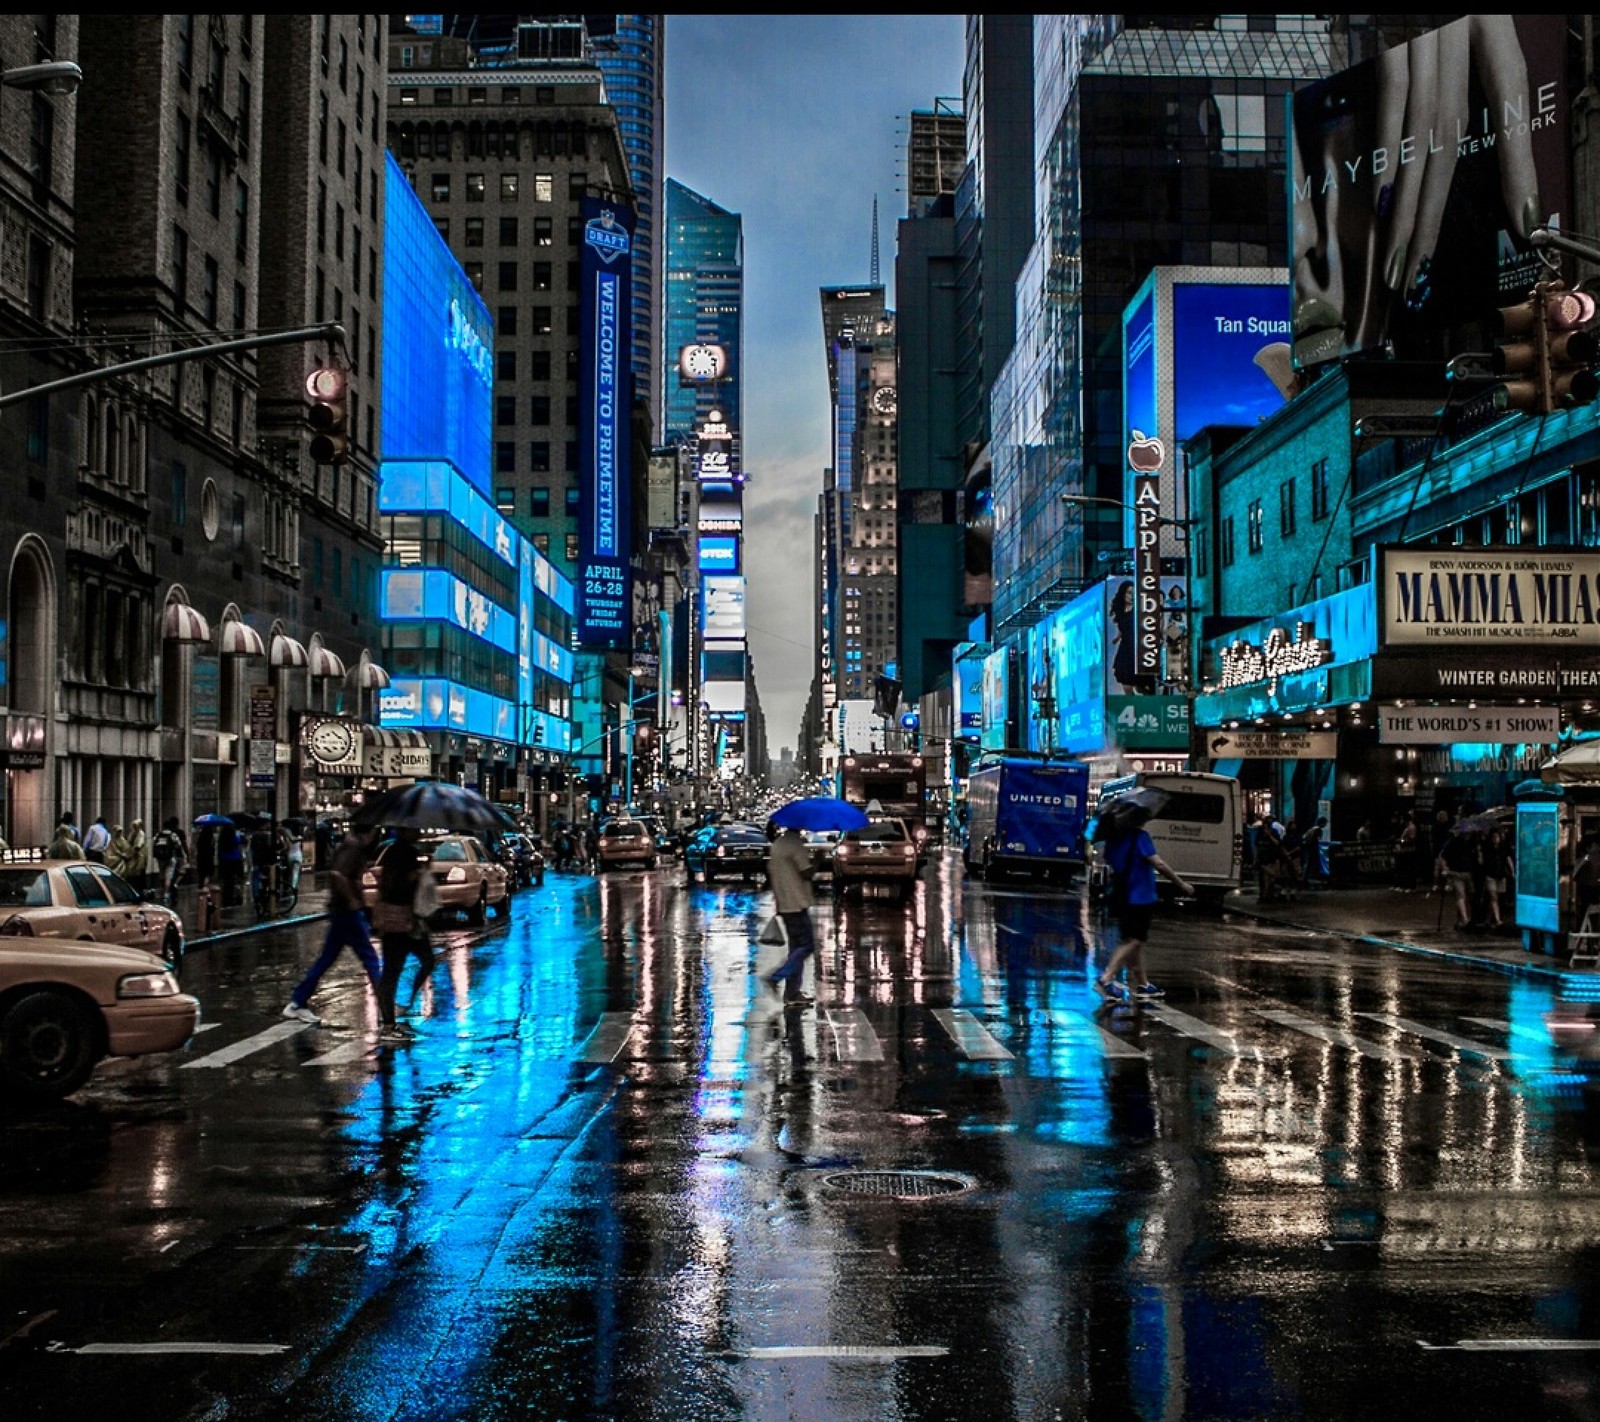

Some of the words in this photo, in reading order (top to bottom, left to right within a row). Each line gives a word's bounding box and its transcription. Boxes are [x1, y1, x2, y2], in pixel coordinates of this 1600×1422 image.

[1457, 134, 1496, 158] NEW
[1504, 111, 1557, 140] YORK
[1293, 82, 1557, 203] MAYBELLINE
[589, 231, 625, 247] DRAFT
[1215, 317, 1243, 332] Tan
[601, 281, 614, 385] WELCOME
[600, 391, 612, 418] TO
[599, 423, 612, 549] PRIMETIME
[585, 565, 624, 580] APRIL
[1429, 560, 1454, 570] BENNY
[1457, 560, 1504, 570] ANDERSSON
[1505, 561, 1512, 570] &
[586, 581, 623, 595] 26-28
[585, 598, 623, 608] THURSDAY
[1396, 572, 1524, 623] MAMMA
[591, 609, 617, 618] FRIDAY
[585, 618, 622, 629] SATURDAY
[1426, 627, 1441, 637] THE
[1443, 627, 1472, 637] SMASH
[1473, 627, 1487, 637] HIT
[1489, 627, 1524, 637] MUSICAL
[1439, 669, 1495, 685] WINTER
[1500, 670, 1556, 685] GARDEN
[1117, 705, 1136, 727] 4
[1387, 717, 1414, 731] THE
[1417, 717, 1481, 732] WORLD'S
[1485, 718, 1501, 731] #1
[1507, 718, 1554, 732] SHOW!
[1010, 794, 1062, 805] UNITED
